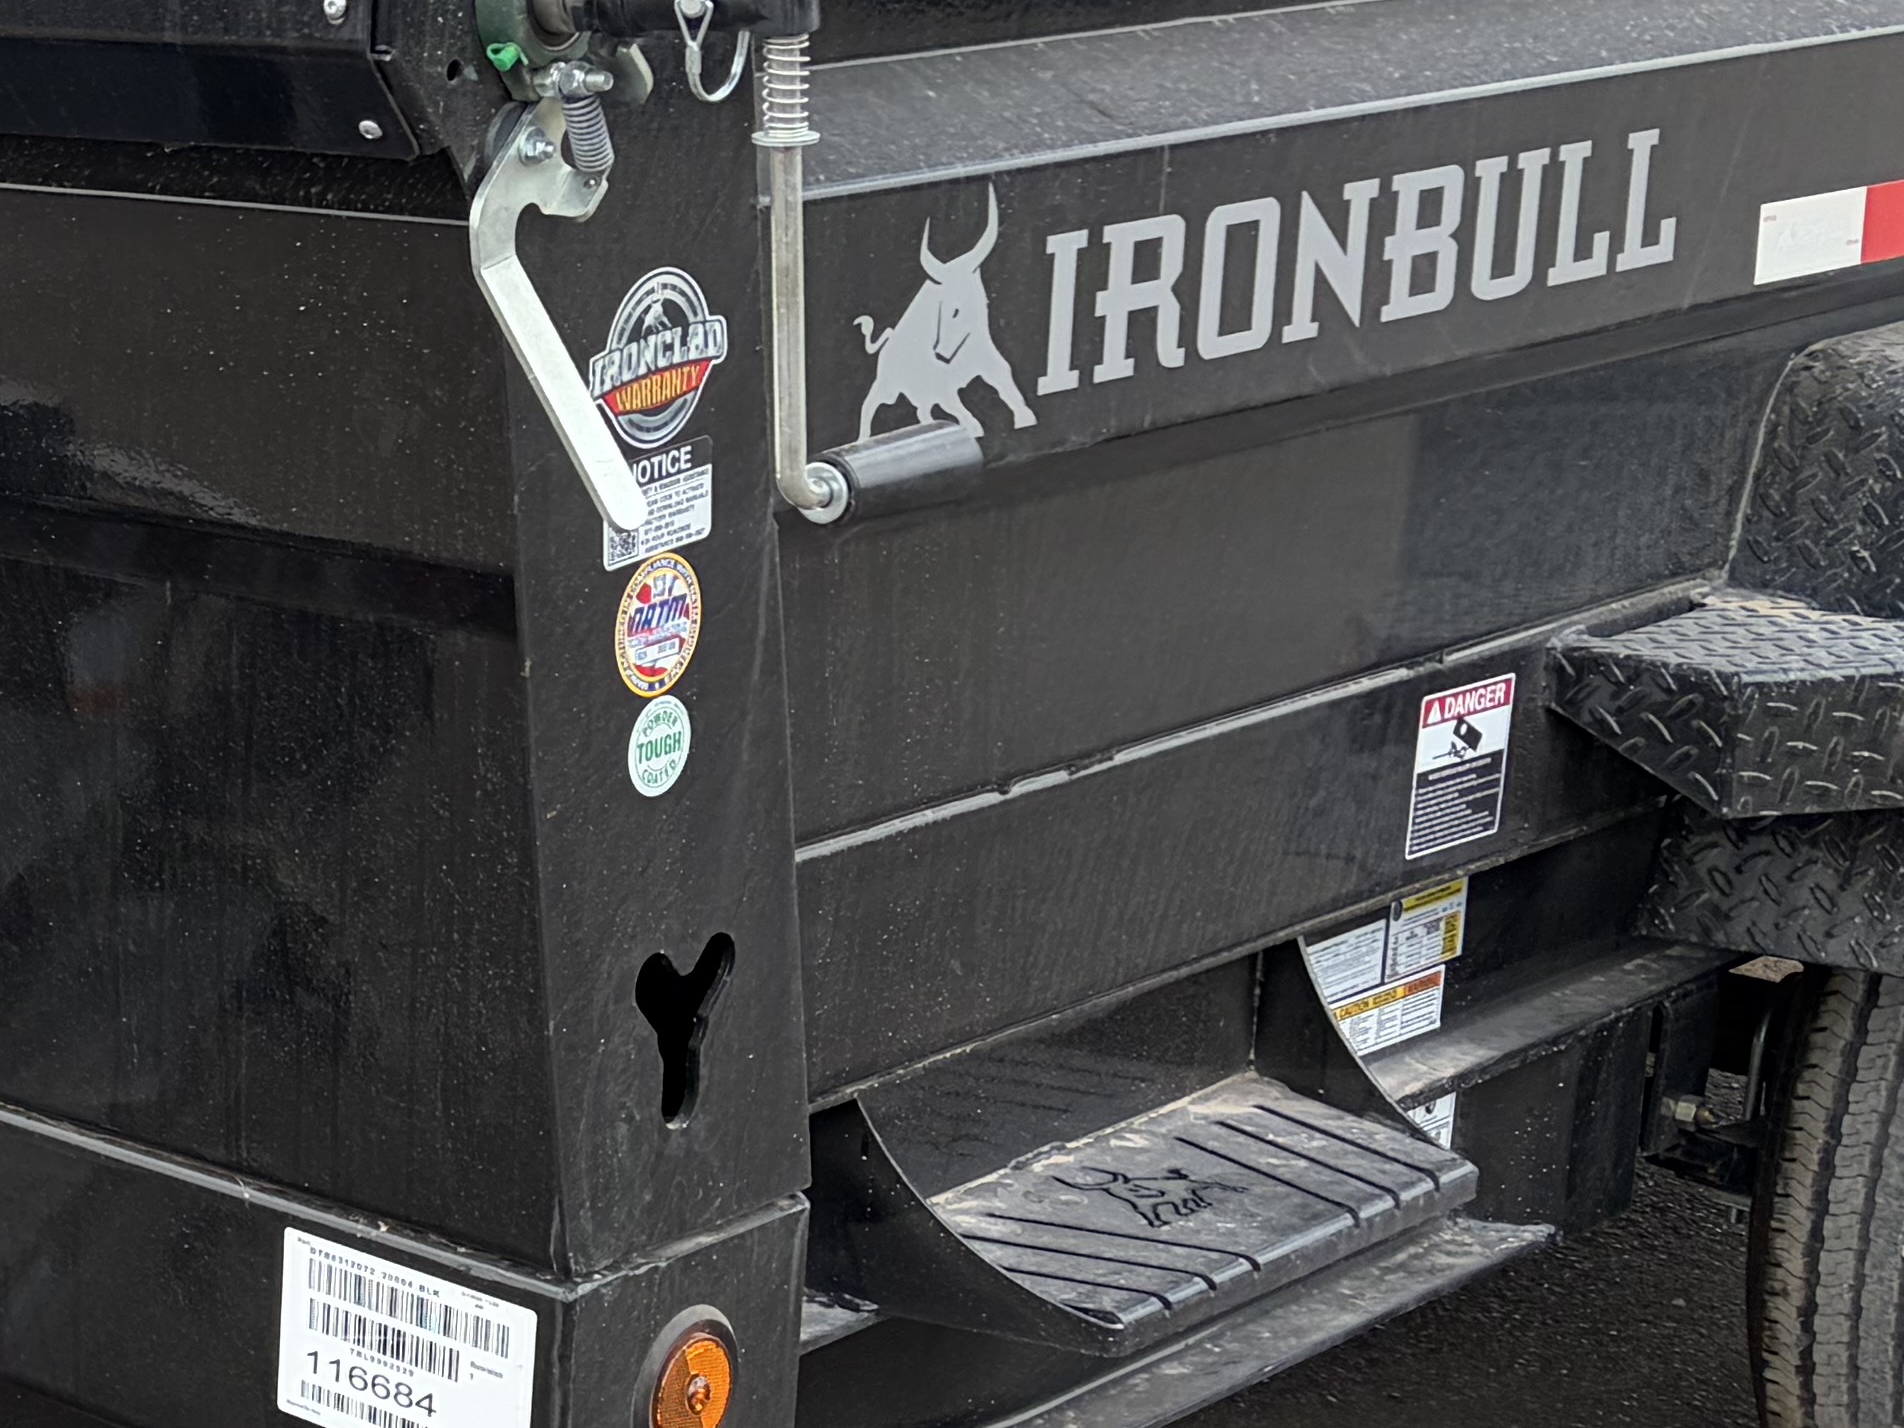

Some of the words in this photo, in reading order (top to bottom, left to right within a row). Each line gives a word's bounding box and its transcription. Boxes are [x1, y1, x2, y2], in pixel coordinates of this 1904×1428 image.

[1037, 128, 1677, 396] IRONBULL
[592, 321, 724, 399] IRONCLAD
[616, 365, 700, 412] WARRANTY
[1444, 682, 1506, 719] DANGER
[637, 731, 682, 764] TOUGH
[306, 1350, 437, 1418] 116684
